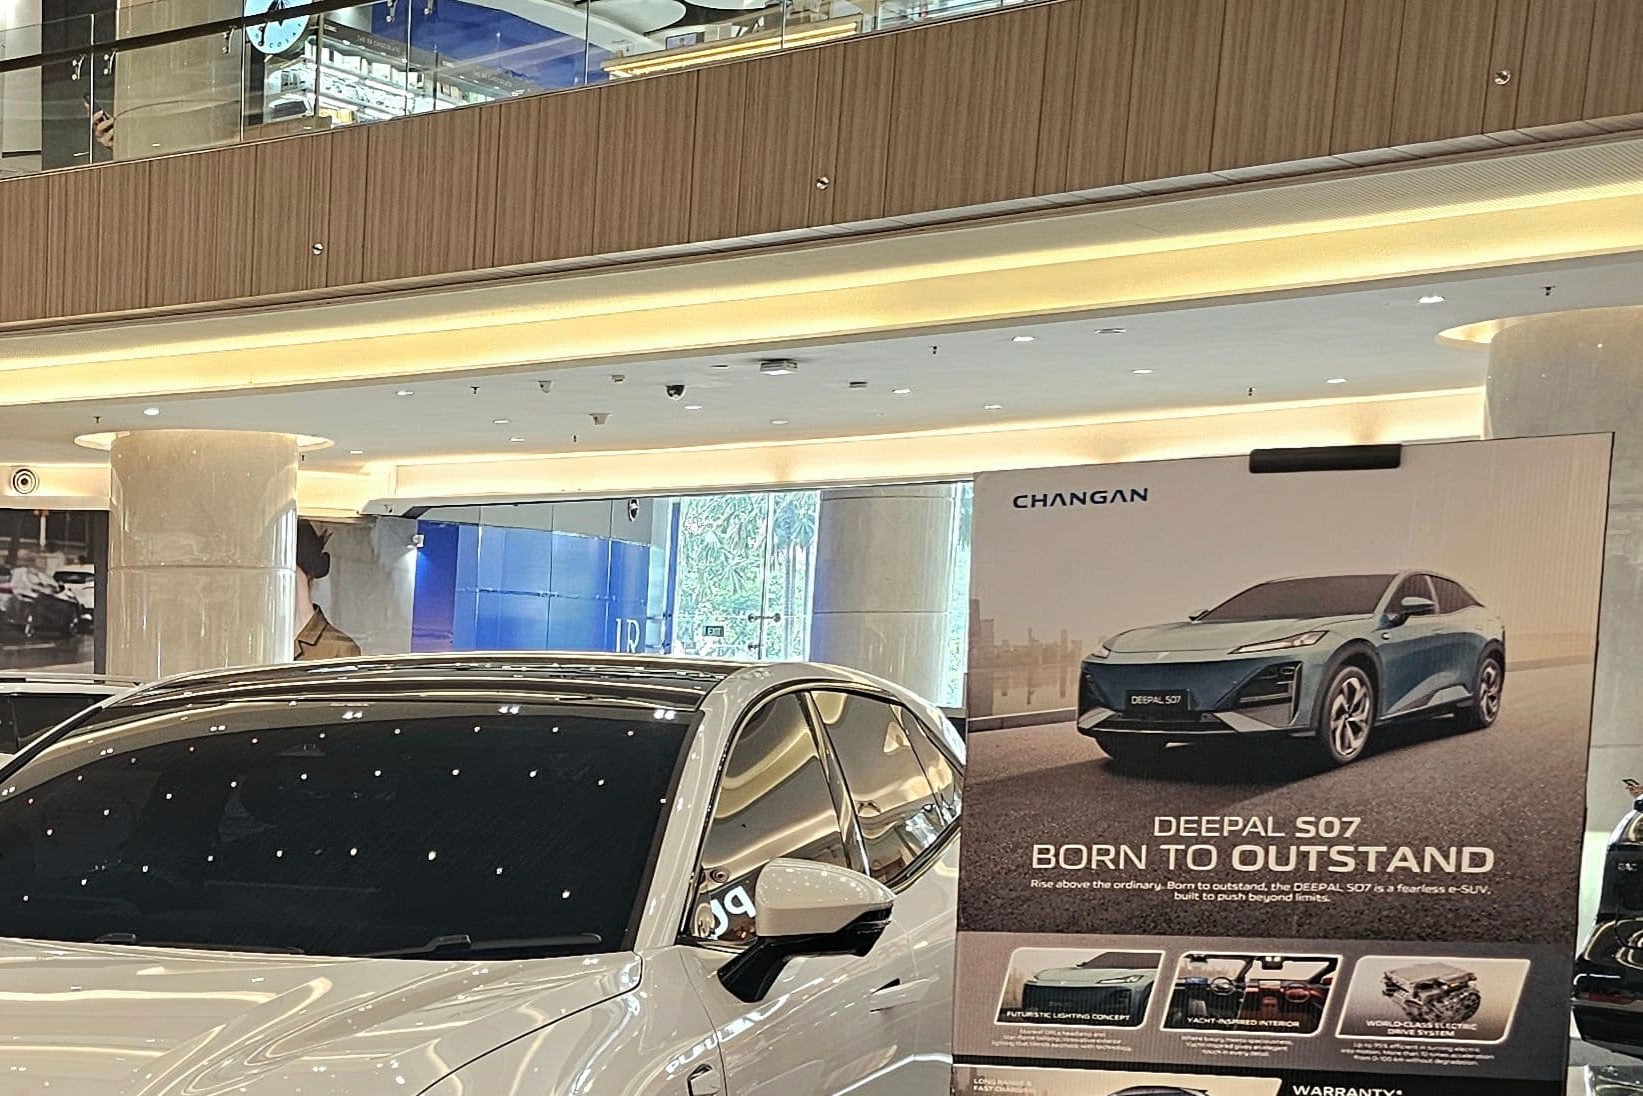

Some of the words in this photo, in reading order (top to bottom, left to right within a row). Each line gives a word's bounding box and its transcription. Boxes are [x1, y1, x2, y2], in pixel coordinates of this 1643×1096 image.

[1012, 488, 1148, 509] CHANGAN
[1131, 695, 1164, 705] DEEPAL
[1165, 695, 1182, 705] S07
[1153, 816, 1286, 838] DEEPAL
[1294, 816, 1362, 839] S07
[1031, 844, 1147, 871] BORN
[1159, 844, 1218, 872] TO
[1232, 845, 1495, 874] OUTSTAND
[1031, 879, 1054, 889] Rise
[1056, 880, 1090, 890] above
[1092, 880, 1111, 890] the
[1167, 881, 1196, 890] Born
[1197, 882, 1210, 891] to
[1270, 882, 1291, 892] the
[1293, 882, 1343, 893] DEEPAL
[1346, 883, 1372, 893] S07
[1374, 883, 1385, 893] is
[1387, 885, 1394, 893] a
[1397, 883, 1446, 894] fearless
[1174, 891, 1200, 901] built
[1202, 892, 1215, 901] to
[1217, 892, 1246, 903] push
[1248, 892, 1293, 903] beyond
[1295, 893, 1331, 902] limits.
[1006, 1010, 1051, 1019] FUTURISTIC
[1053, 1012, 1091, 1020] LIGHTING
[1092, 1013, 1131, 1021] CONCEPT
[1259, 1019, 1300, 1027] INTERIOR
